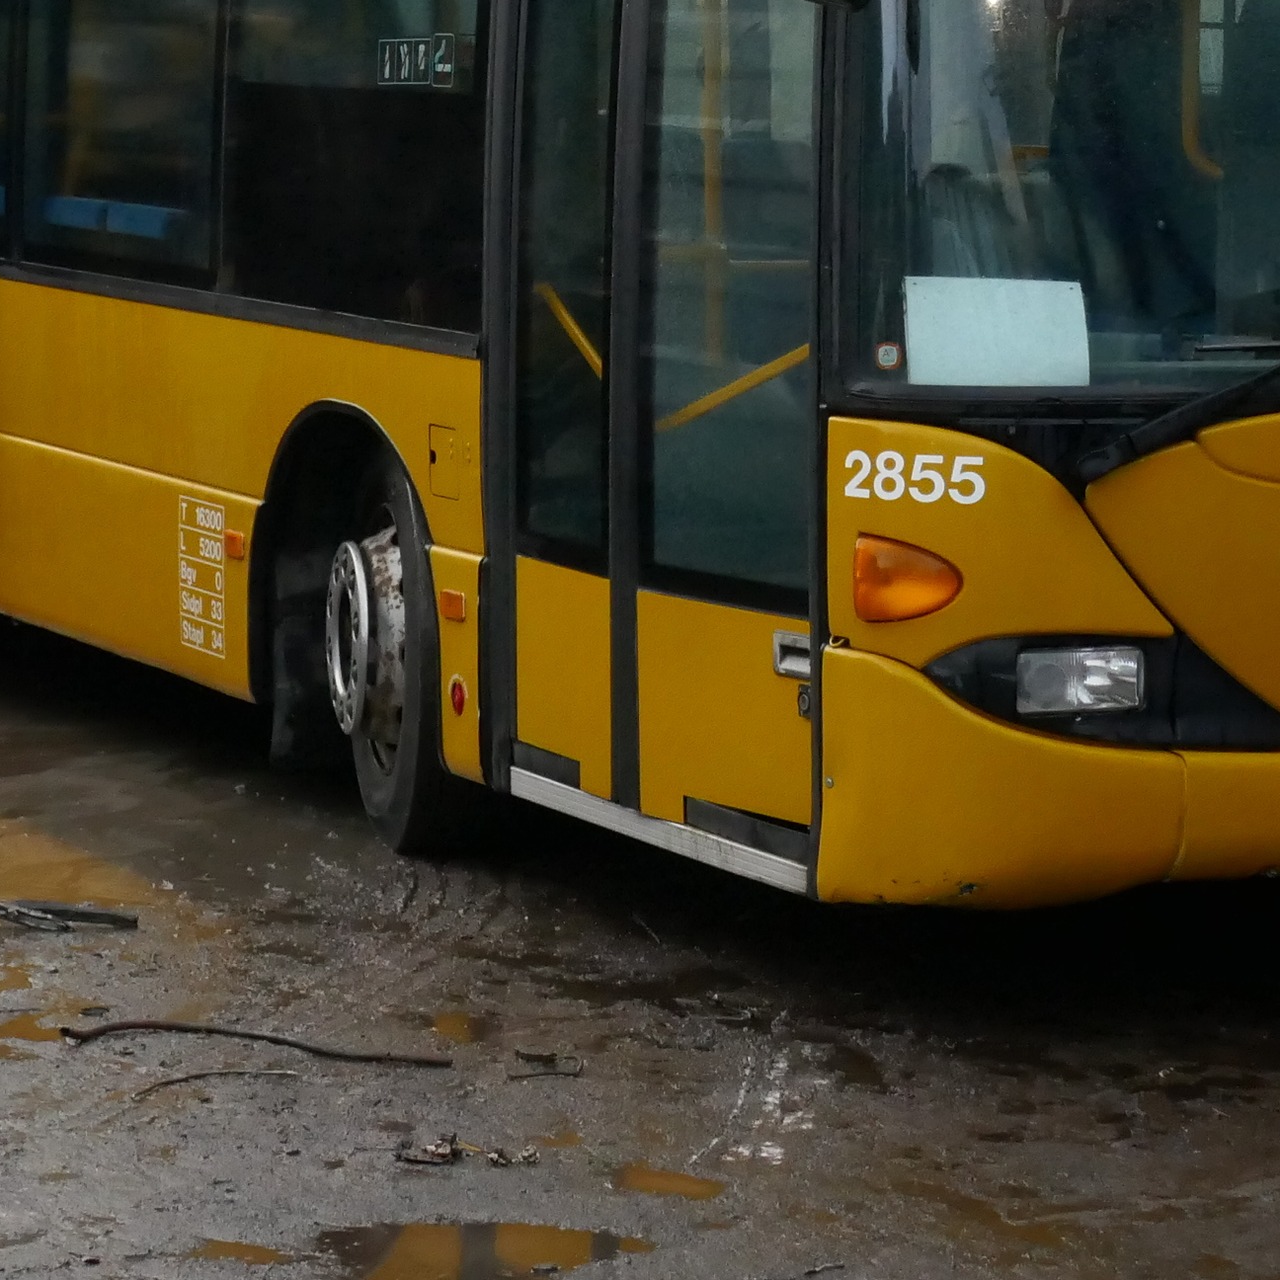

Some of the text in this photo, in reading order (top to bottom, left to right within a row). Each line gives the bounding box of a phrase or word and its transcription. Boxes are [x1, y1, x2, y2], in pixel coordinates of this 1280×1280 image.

[844, 449, 986, 505] 2855
[181, 502, 222, 531] T 16300
[180, 531, 222, 562] L 5200
[214, 570, 222, 592] 0
[210, 599, 222, 621] 33
[211, 630, 223, 651] 34
